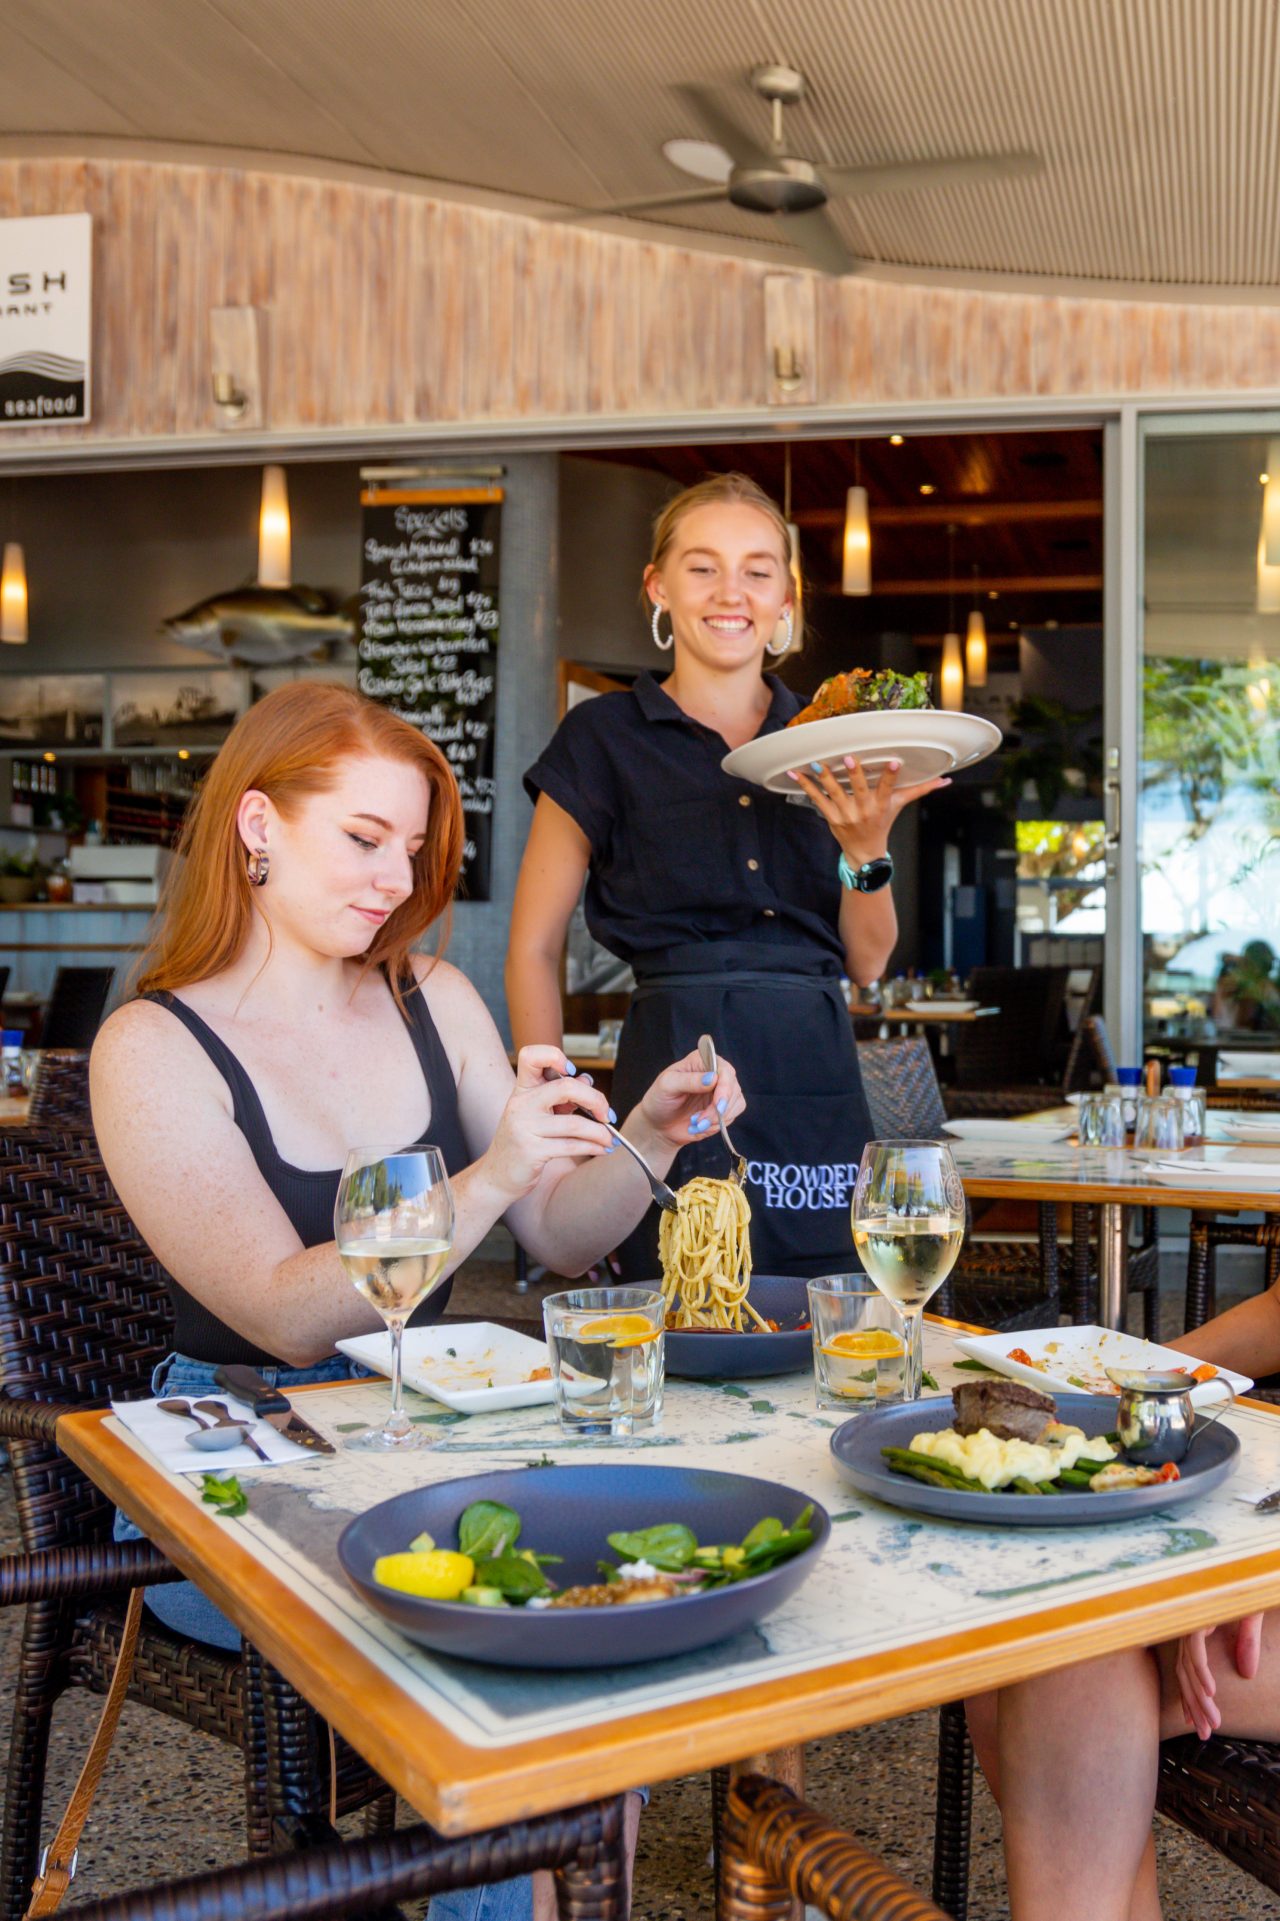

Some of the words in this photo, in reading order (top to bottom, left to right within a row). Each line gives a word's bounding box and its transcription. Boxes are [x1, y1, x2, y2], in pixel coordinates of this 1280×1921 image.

[8, 270, 66, 296] SH
[0, 302, 53, 317] ANT
[4, 394, 77, 417] seafood
[394, 505, 469, 535] Specials
[747, 1160, 864, 1189] CROWDED
[765, 1185, 850, 1211] HOUSE
